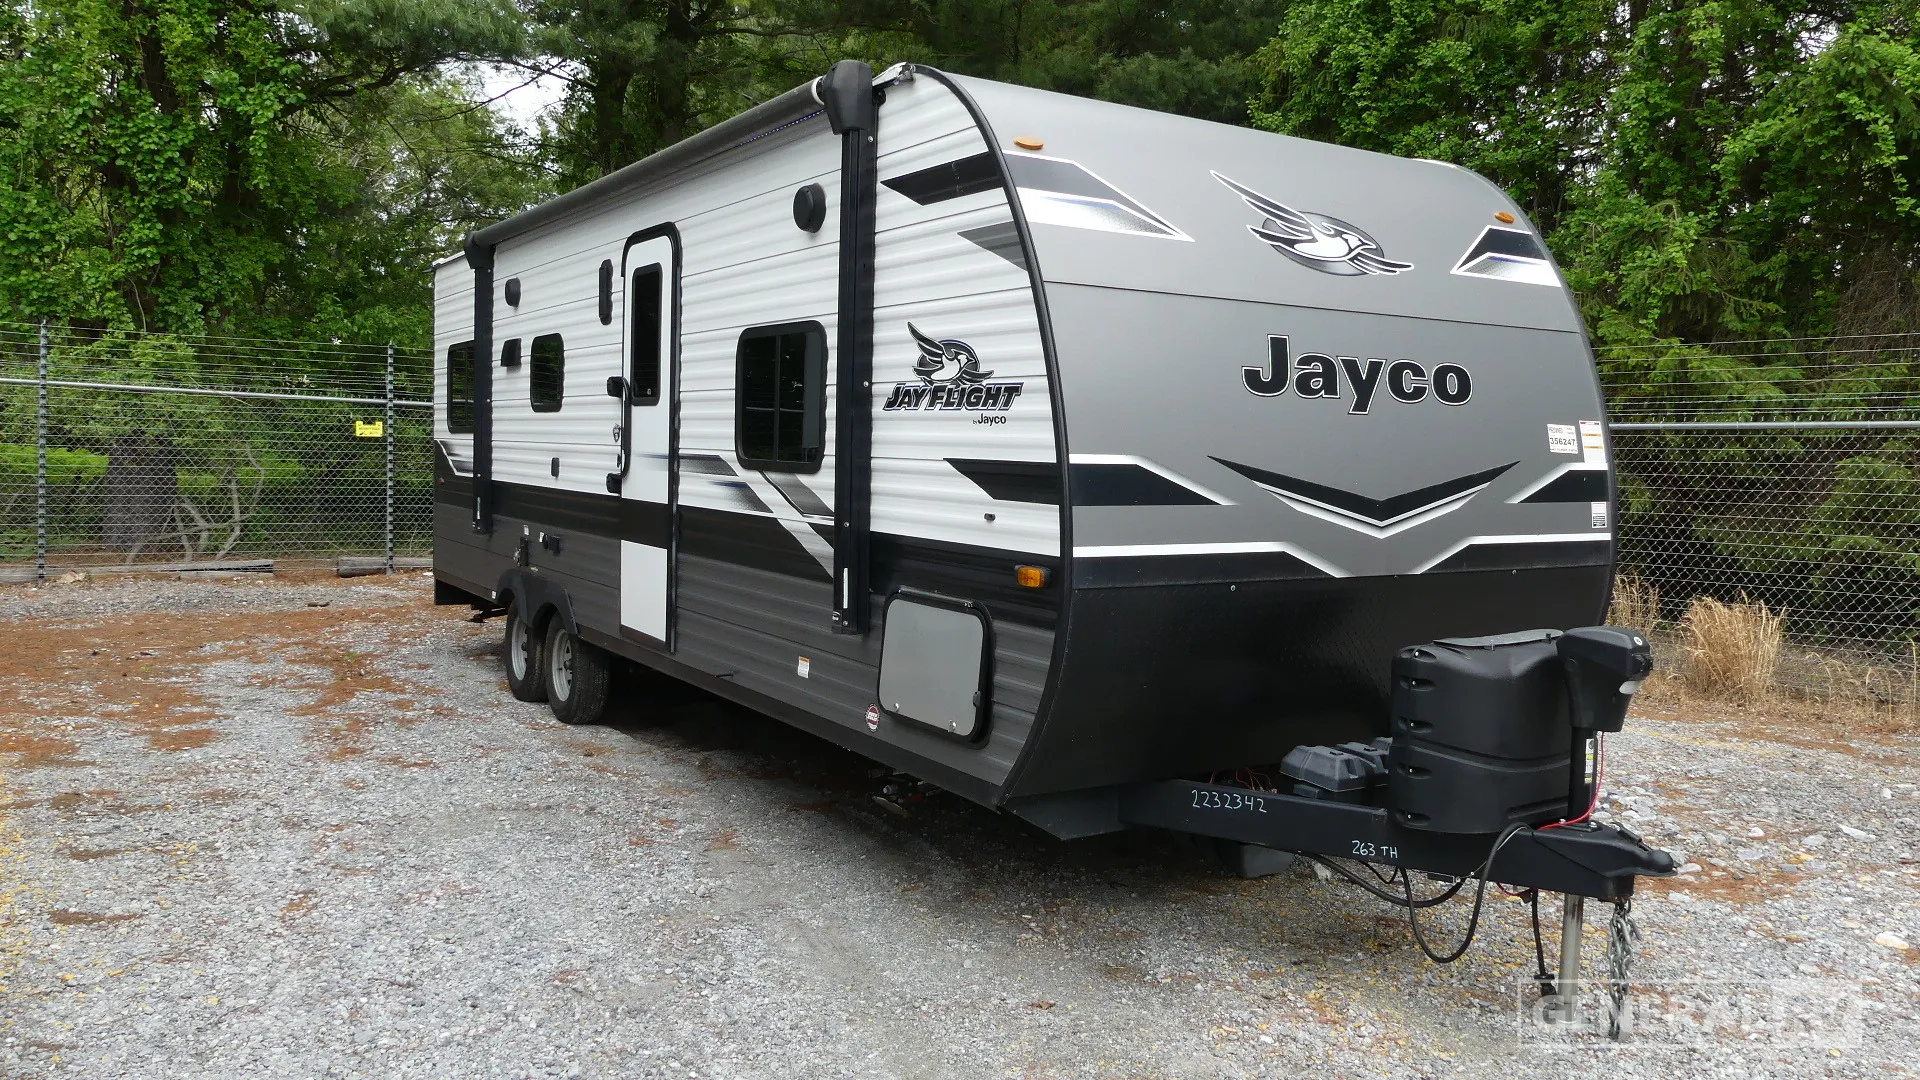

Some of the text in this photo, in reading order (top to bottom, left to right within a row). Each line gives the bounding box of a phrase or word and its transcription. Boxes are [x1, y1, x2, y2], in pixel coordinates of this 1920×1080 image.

[1241, 334, 1473, 415] Jayco
[883, 382, 1024, 411] JAY FLIGHT
[977, 413, 1007, 426] Jayco
[1549, 437, 1576, 446] 356247
[1191, 789, 1267, 813] 2232342
[1352, 840, 1398, 859] 263 TH
